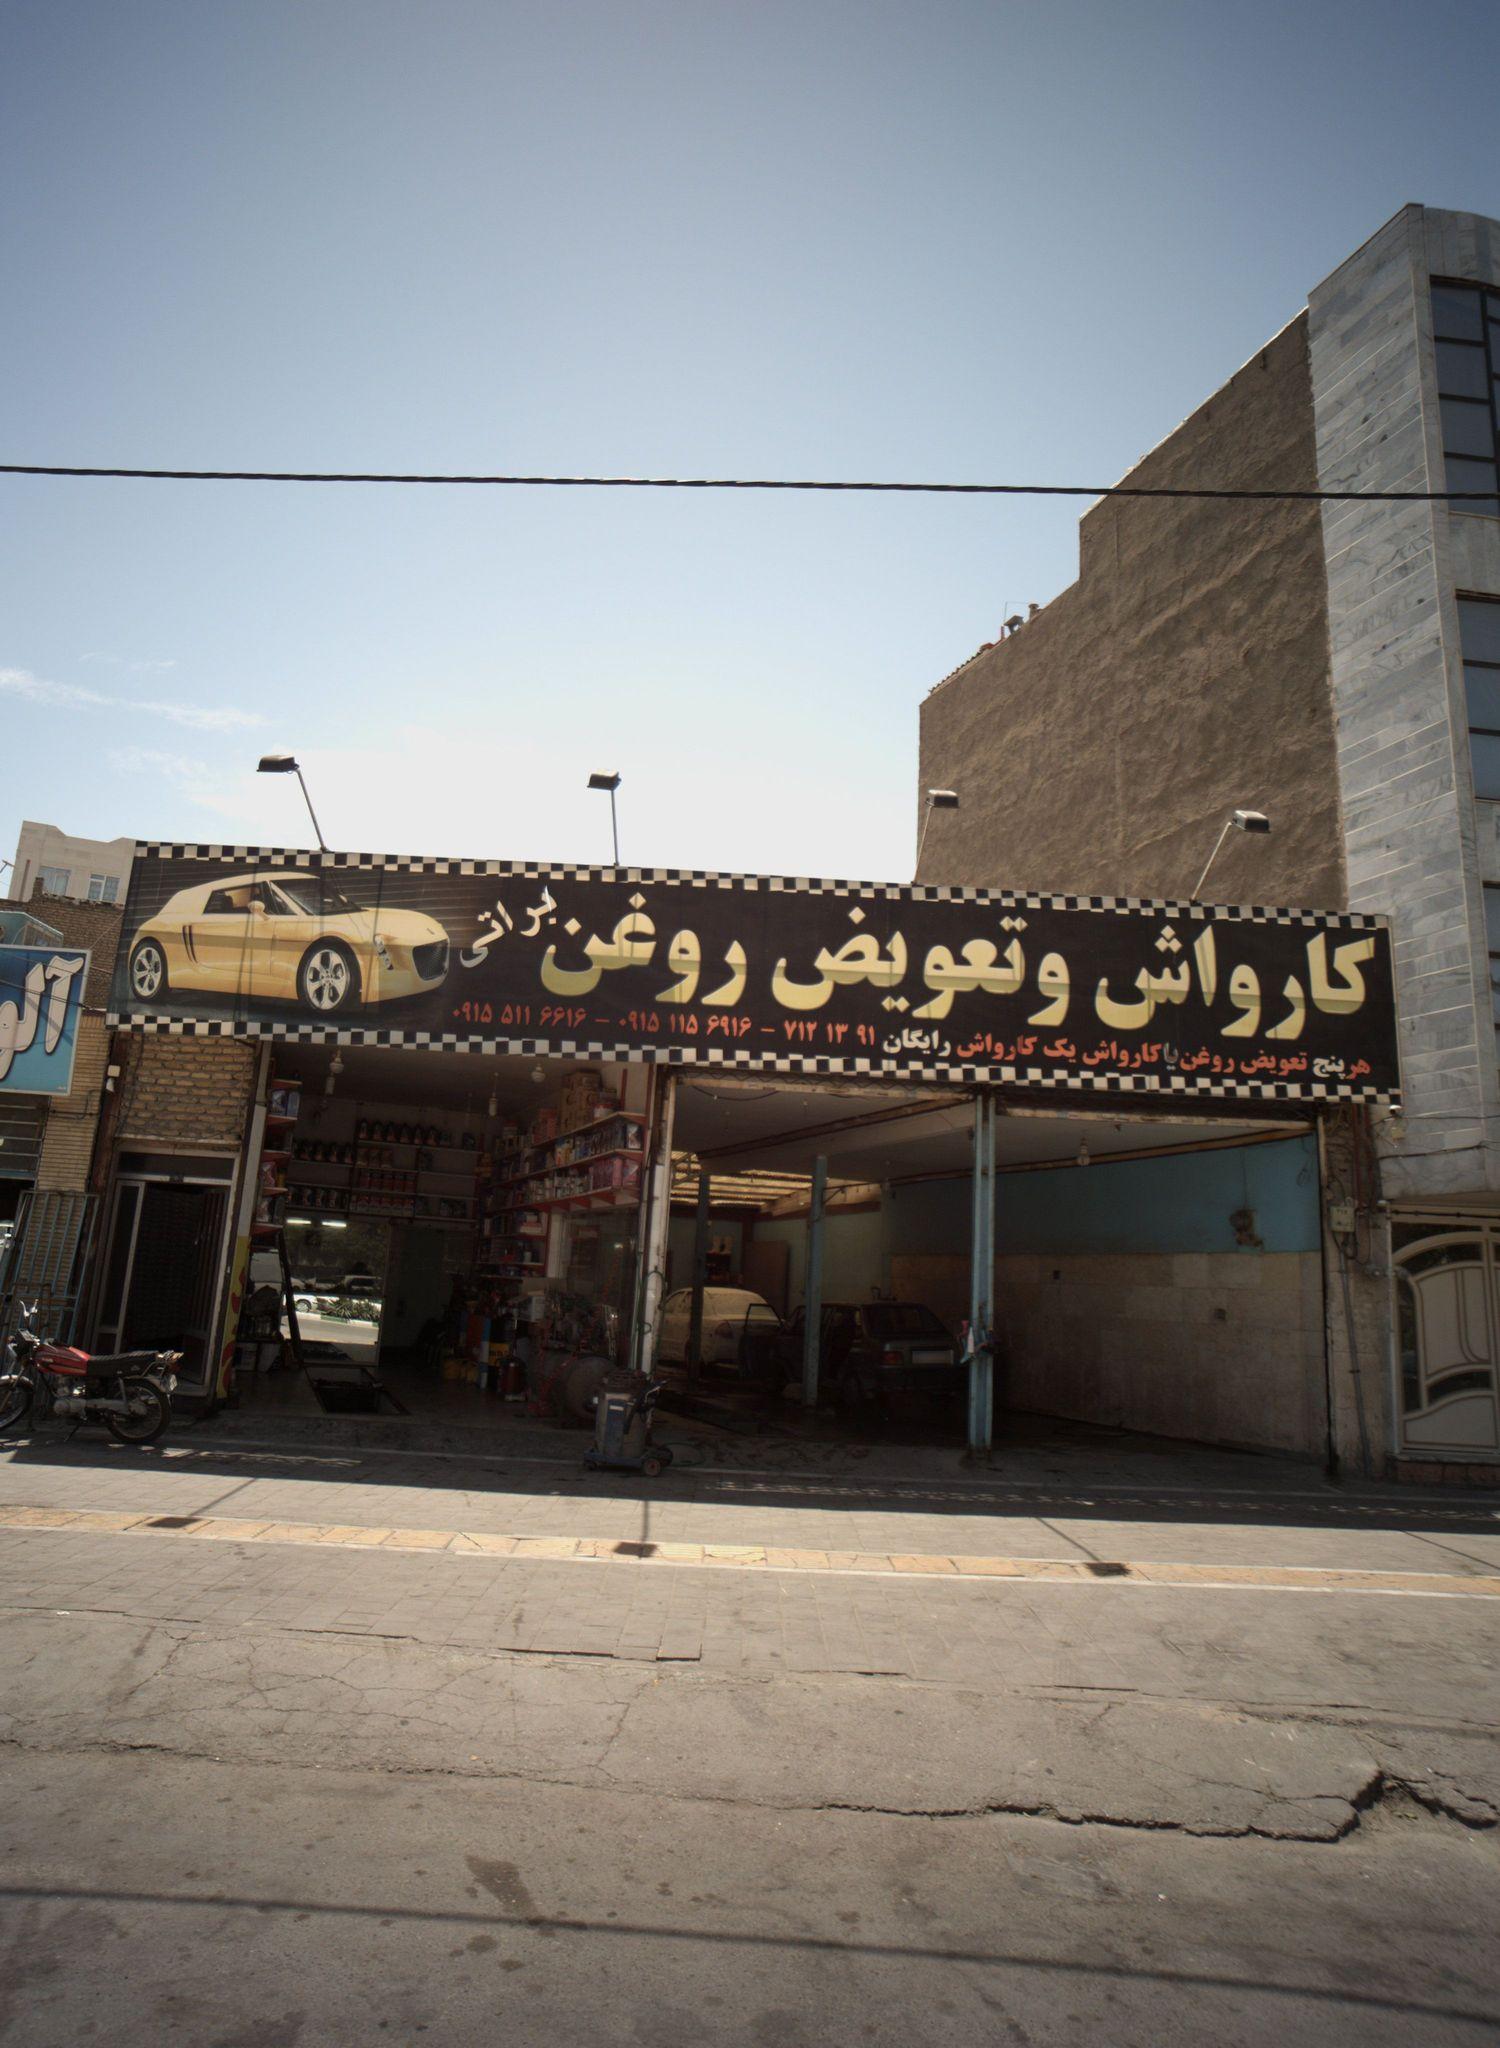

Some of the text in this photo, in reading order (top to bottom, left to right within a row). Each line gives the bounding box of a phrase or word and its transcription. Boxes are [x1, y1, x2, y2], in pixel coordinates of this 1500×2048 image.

[540, 892, 747, 1006] روغن
[771, 906, 1028, 1020] تعویض
[1027, 952, 1071, 1027] و
[1094, 924, 1376, 1040] کارواش
[882, 1027, 1371, 1080] هر پنج تعویض روغن یا کارواش یک کارواش رایگان
